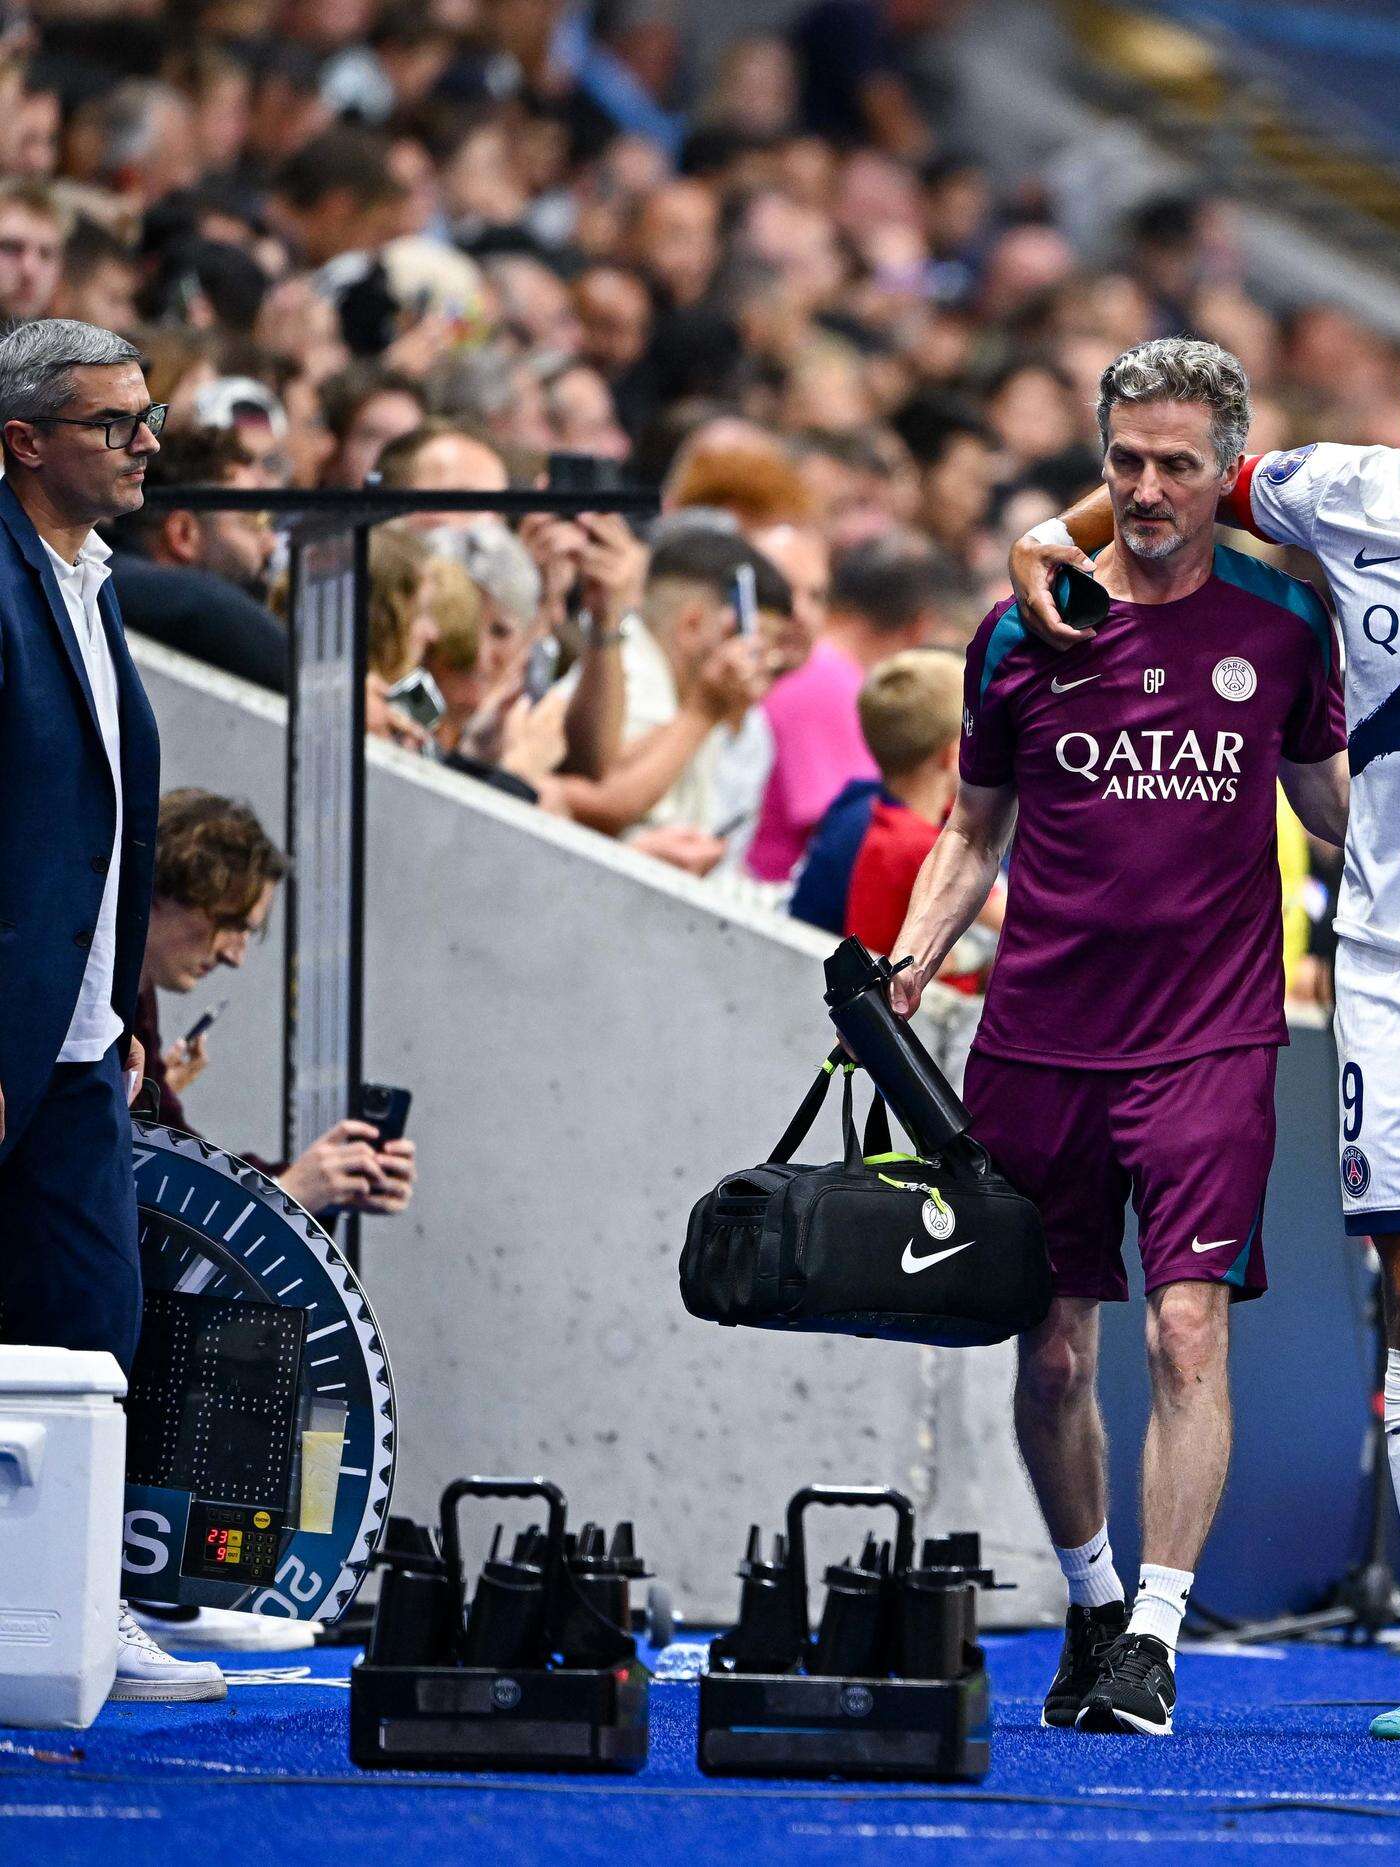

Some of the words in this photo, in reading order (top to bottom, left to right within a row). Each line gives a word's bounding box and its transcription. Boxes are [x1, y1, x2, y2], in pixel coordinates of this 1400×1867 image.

[1221, 662, 1246, 673] PARIS
[1143, 668, 1165, 694] GP
[1055, 729, 1244, 782] QATAR
[1101, 775, 1238, 803] AIRWAYS
[1342, 1062, 1364, 1141] 9
[207, 1529, 228, 1543] 23
[216, 1547, 226, 1561] 9
